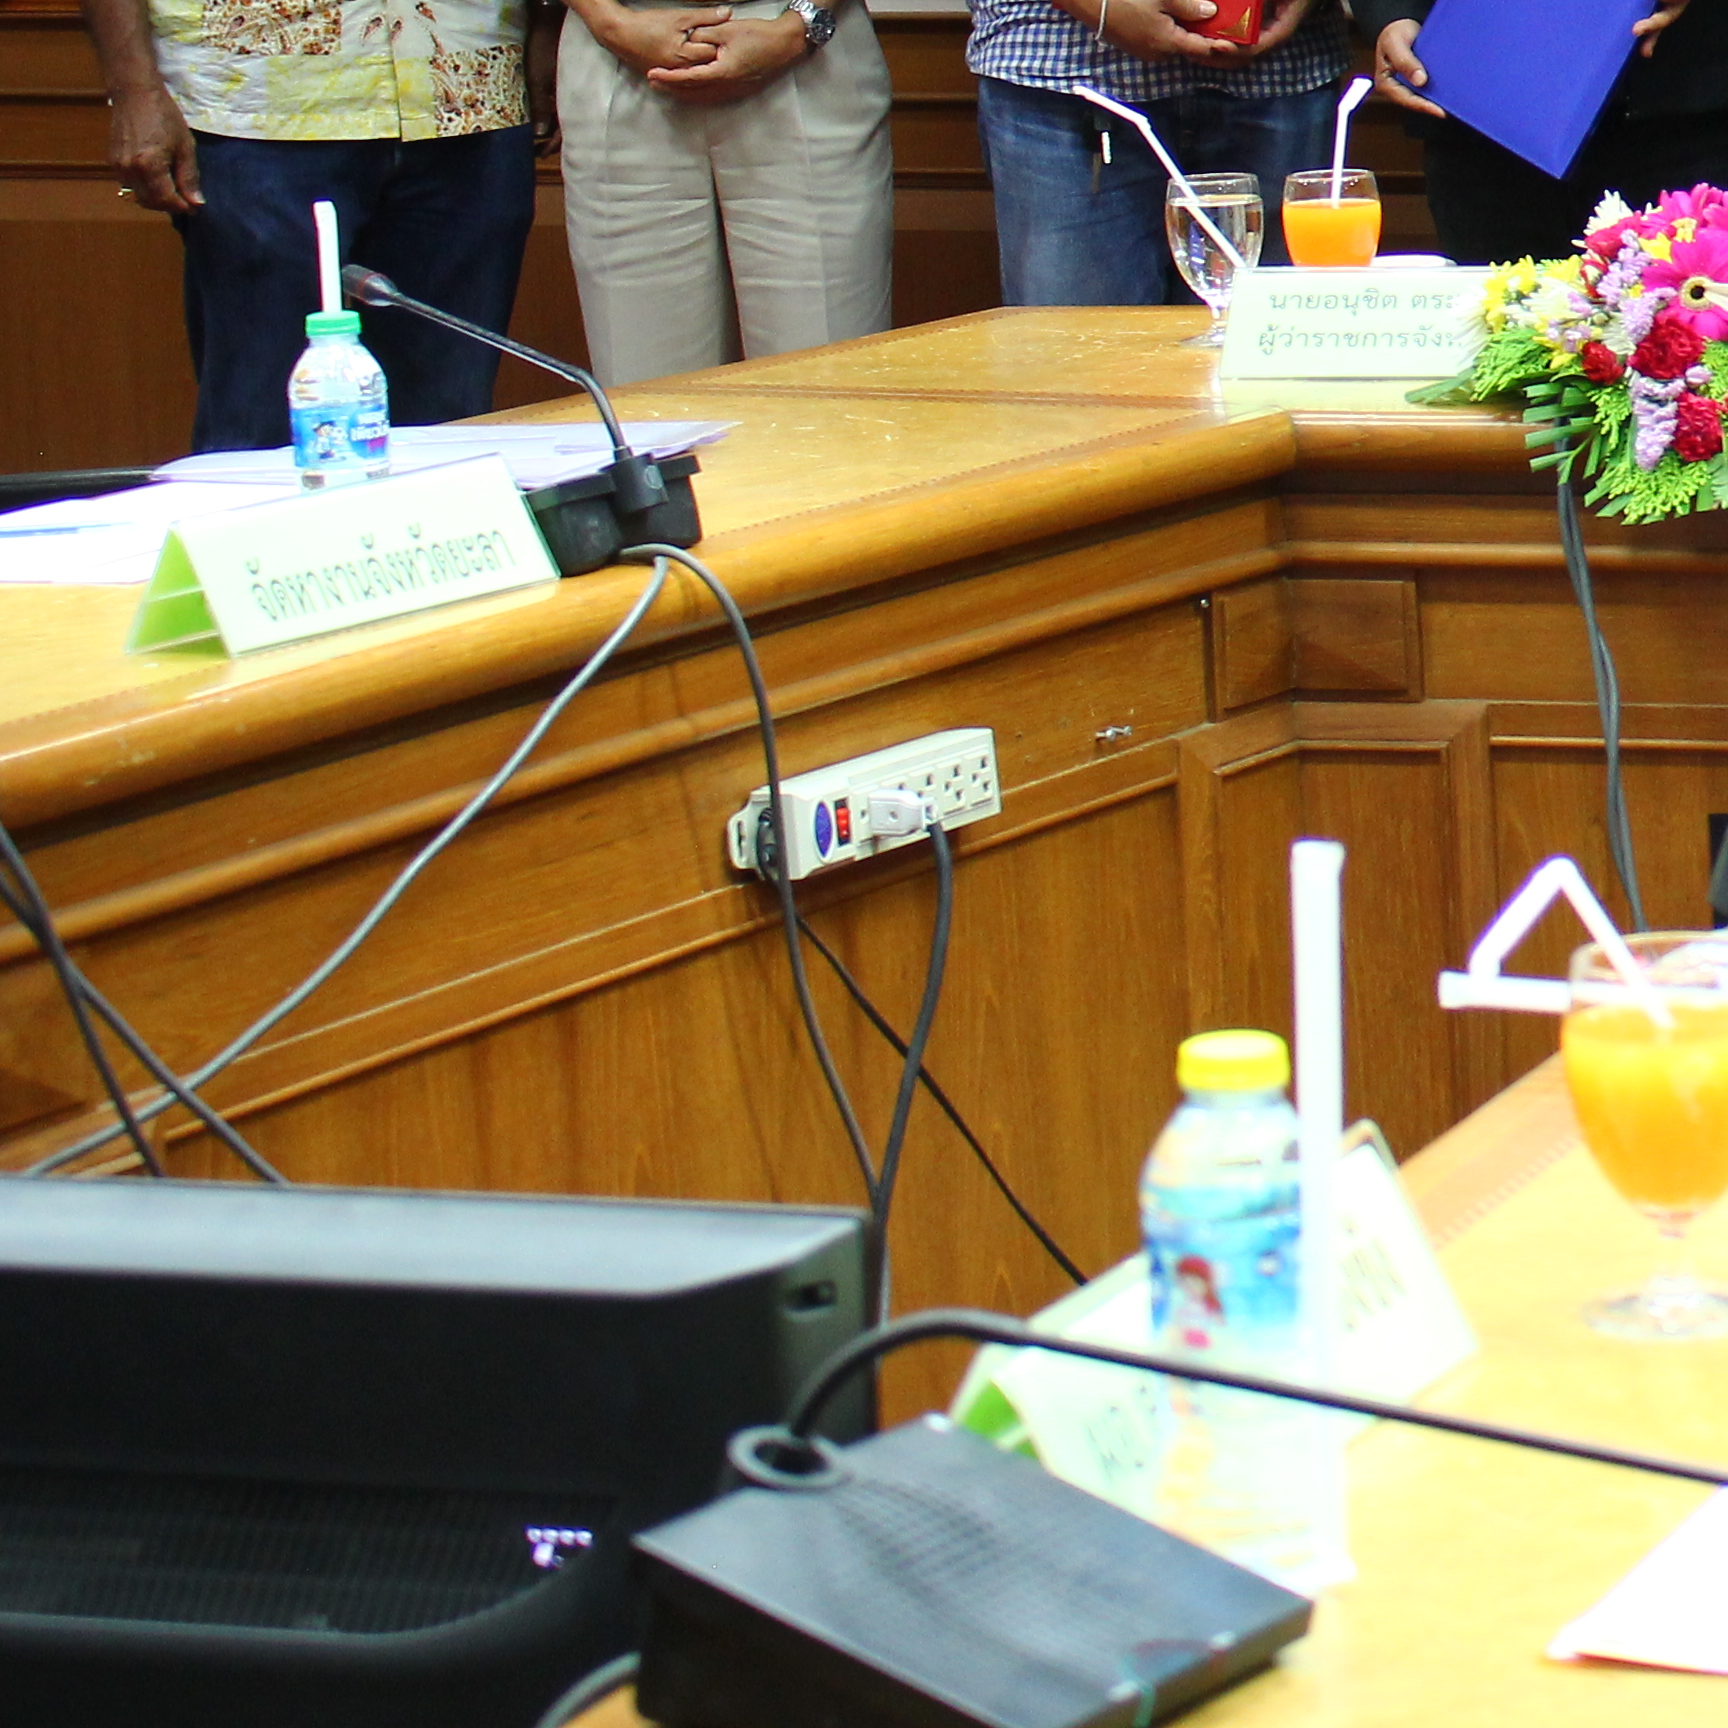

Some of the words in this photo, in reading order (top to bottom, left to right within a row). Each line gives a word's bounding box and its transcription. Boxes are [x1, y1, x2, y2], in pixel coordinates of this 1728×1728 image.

[1270, 288, 1398, 316] นายอนุชิต
[245, 522, 518, 622] จัดหางานจังหวัดยะลา
